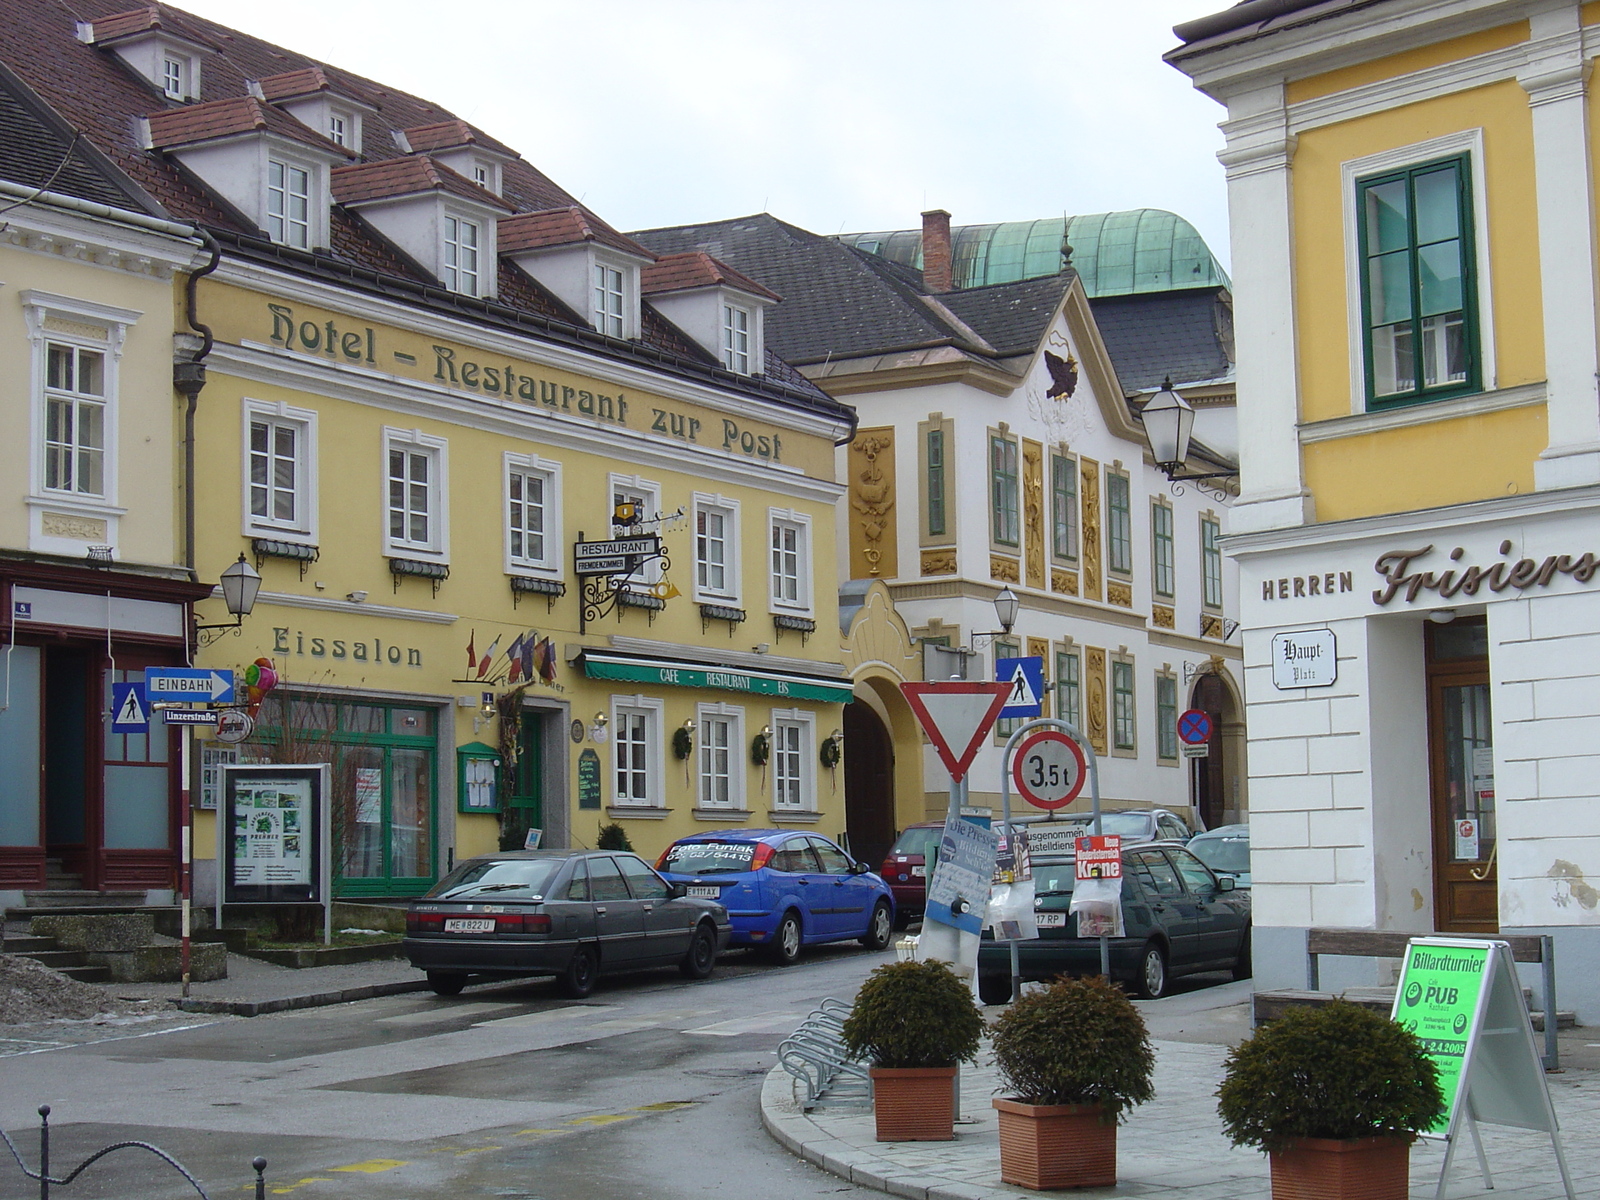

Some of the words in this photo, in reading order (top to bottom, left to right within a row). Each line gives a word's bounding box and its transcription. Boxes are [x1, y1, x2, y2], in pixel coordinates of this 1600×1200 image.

[267, 303, 375, 364] Hotel
[432, 345, 628, 423] Restaurant
[651, 407, 701, 440] zur
[722, 418, 782, 461] Post
[581, 542, 649, 556] RESTAURANT
[578, 559, 624, 570] FREMDENZIMMER
[1262, 571, 1353, 600] HERREN
[272, 627, 422, 667] Eissalon
[158, 679, 213, 691] EINBAHN
[660, 669, 679, 683] CAFE
[706, 673, 750, 689] RESTAURANT
[777, 681, 789, 694] EIS
[166, 710, 217, 722] Linzerstraße
[1029, 755, 1059, 787] 3,5
[1063, 768, 1069, 786] t
[1027, 829, 1084, 842] usgenommen
[670, 844, 700, 853] Foto
[449, 921, 460, 930] ME
[1412, 952, 1486, 973] Billardturnier
[1424, 986, 1459, 1005] PUB
